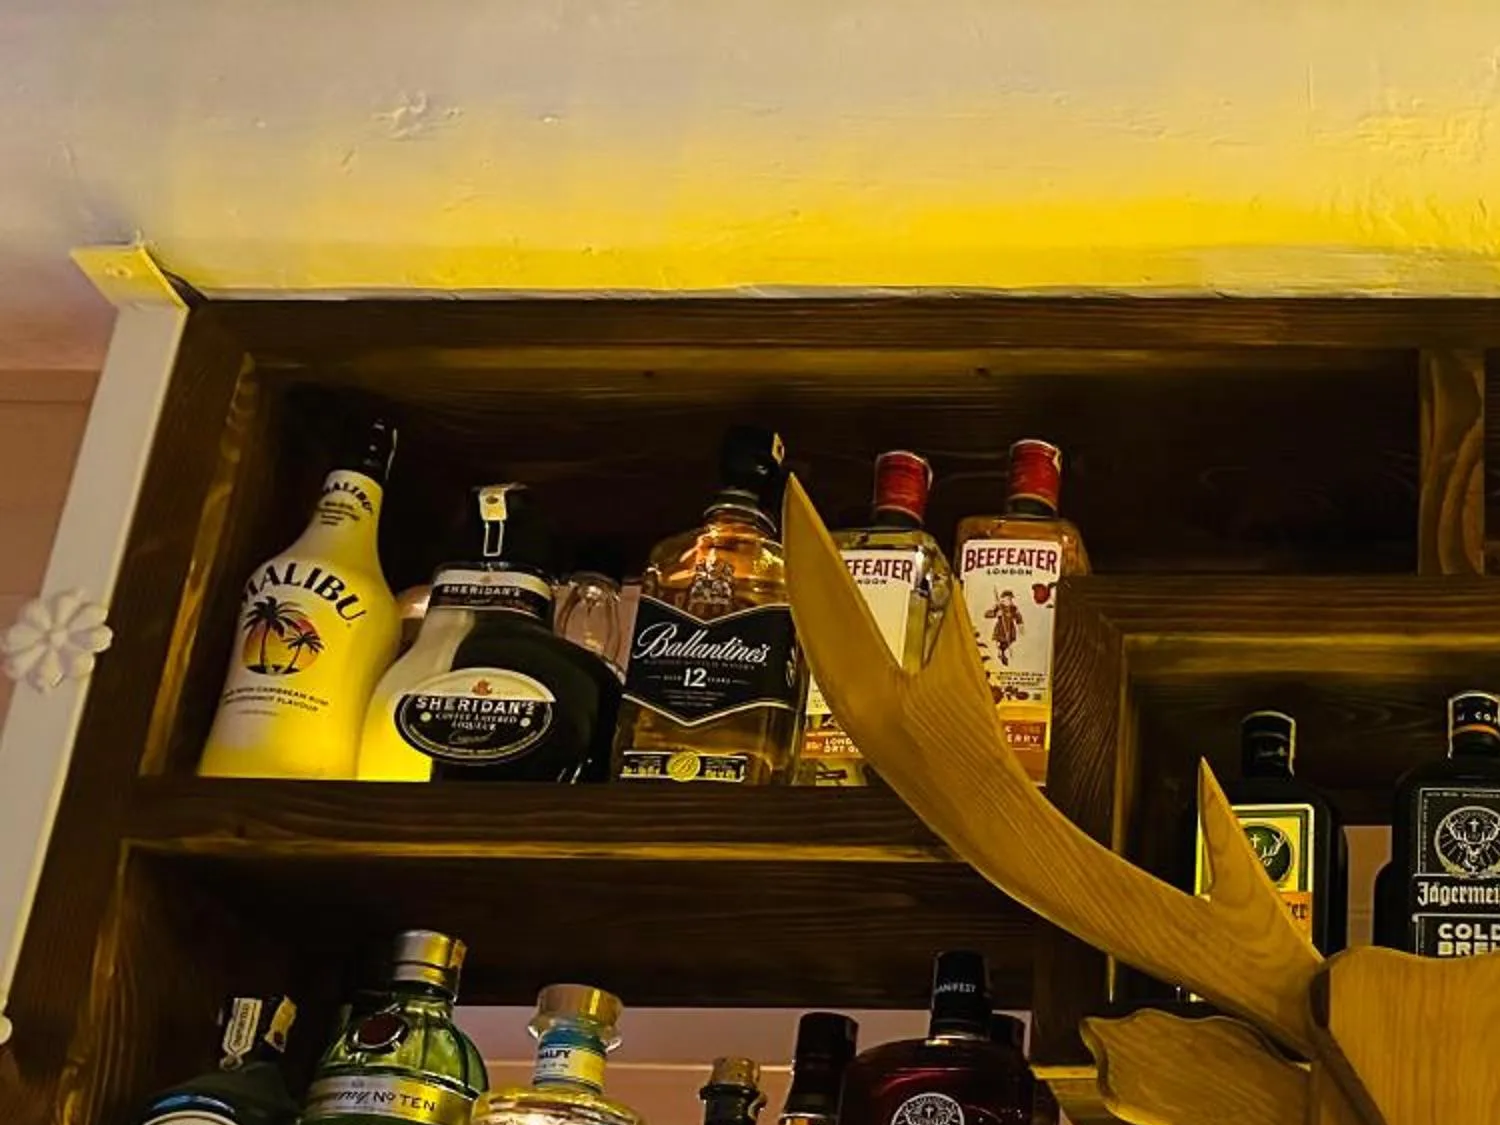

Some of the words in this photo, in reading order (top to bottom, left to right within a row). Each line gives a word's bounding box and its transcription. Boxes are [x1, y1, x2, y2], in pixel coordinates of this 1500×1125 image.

[964, 547, 1058, 575] BEEFEATER
[986, 567, 1033, 576] LONDON
[632, 621, 772, 664] Ballantine's
[683, 667, 708, 688] 12
[415, 697, 535, 715] SHERIDAN'S
[399, 1093, 436, 1112] TEN
